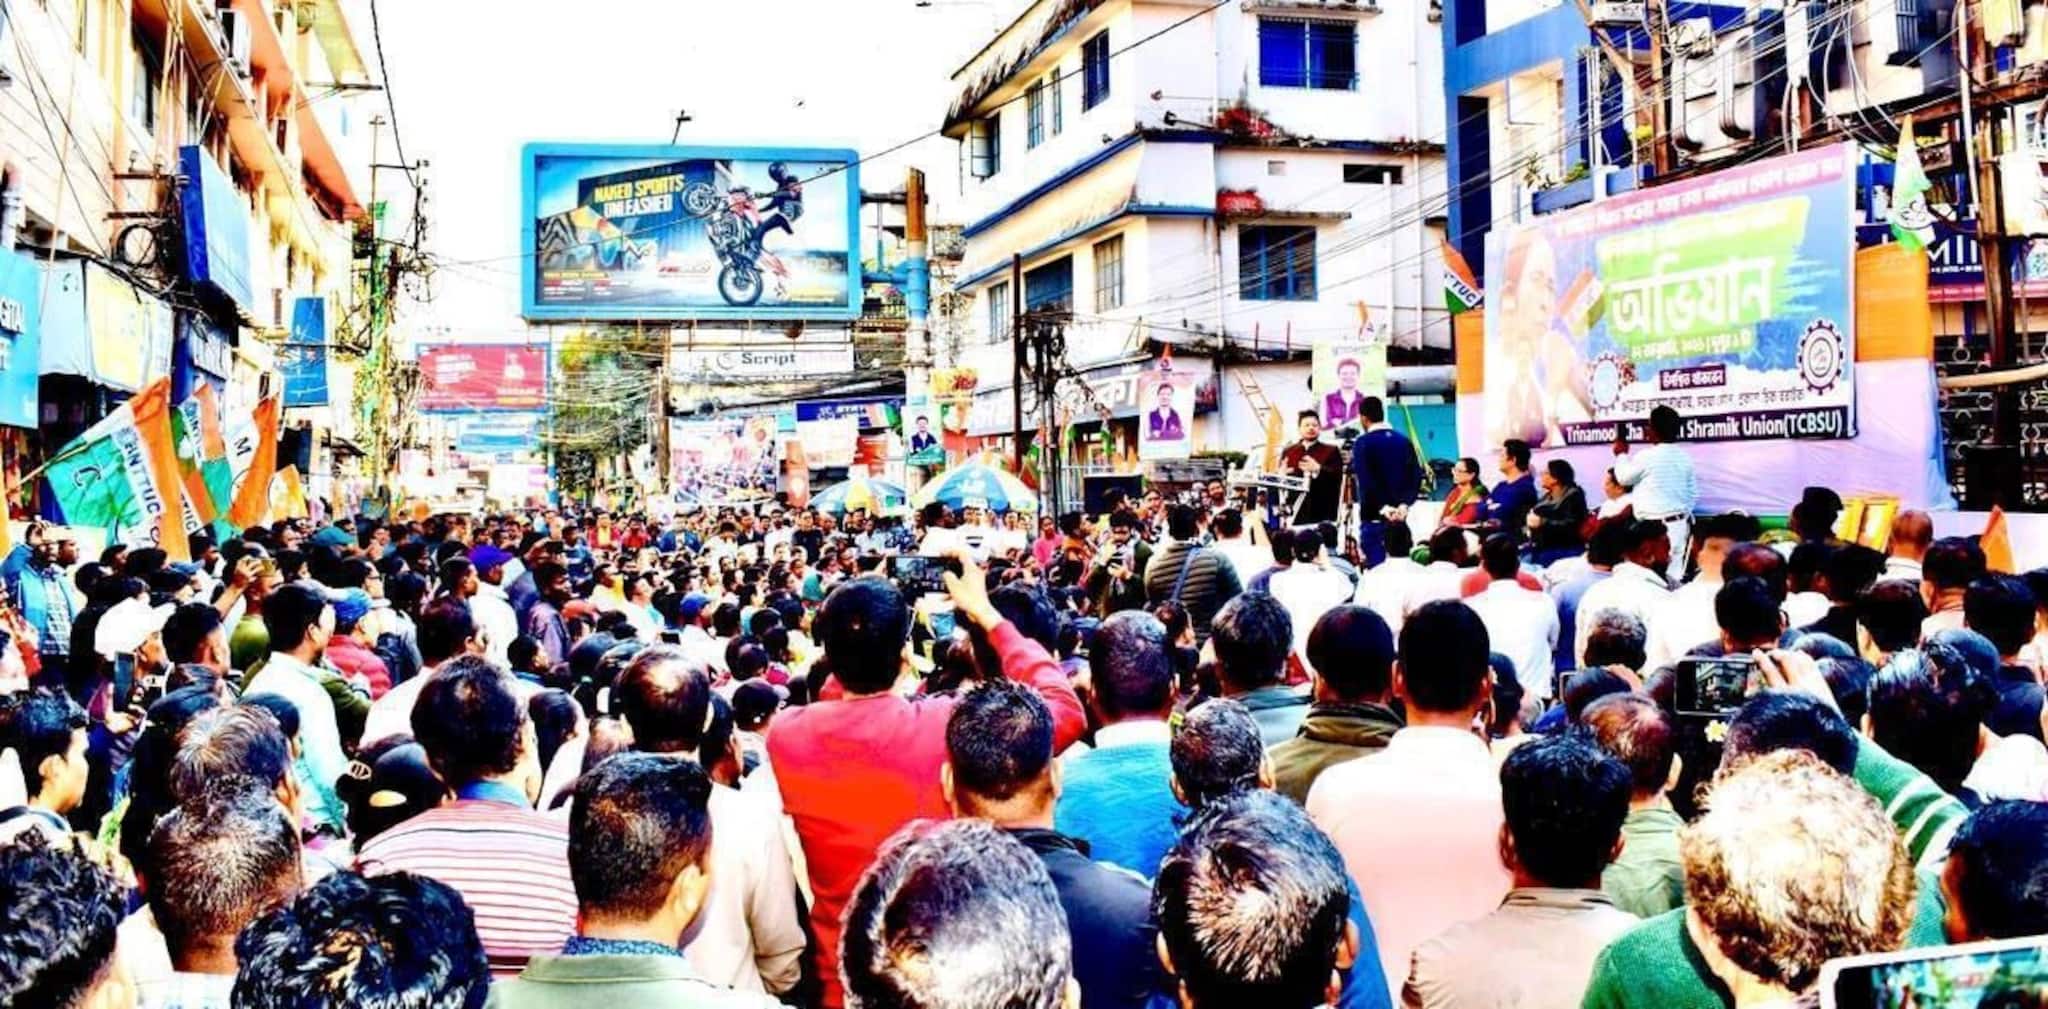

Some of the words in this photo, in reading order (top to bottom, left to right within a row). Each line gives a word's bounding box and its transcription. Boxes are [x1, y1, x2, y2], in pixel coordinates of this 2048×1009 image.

[594, 183, 632, 203] NAKED
[634, 174, 685, 197] SPORTS
[603, 194, 673, 218] UNLEASHED
[1608, 252, 1776, 334] অভিযান
[741, 352, 797, 366] Script
[1565, 423, 1617, 443] Trinamool
[1686, 416, 1740, 439] Shramik
